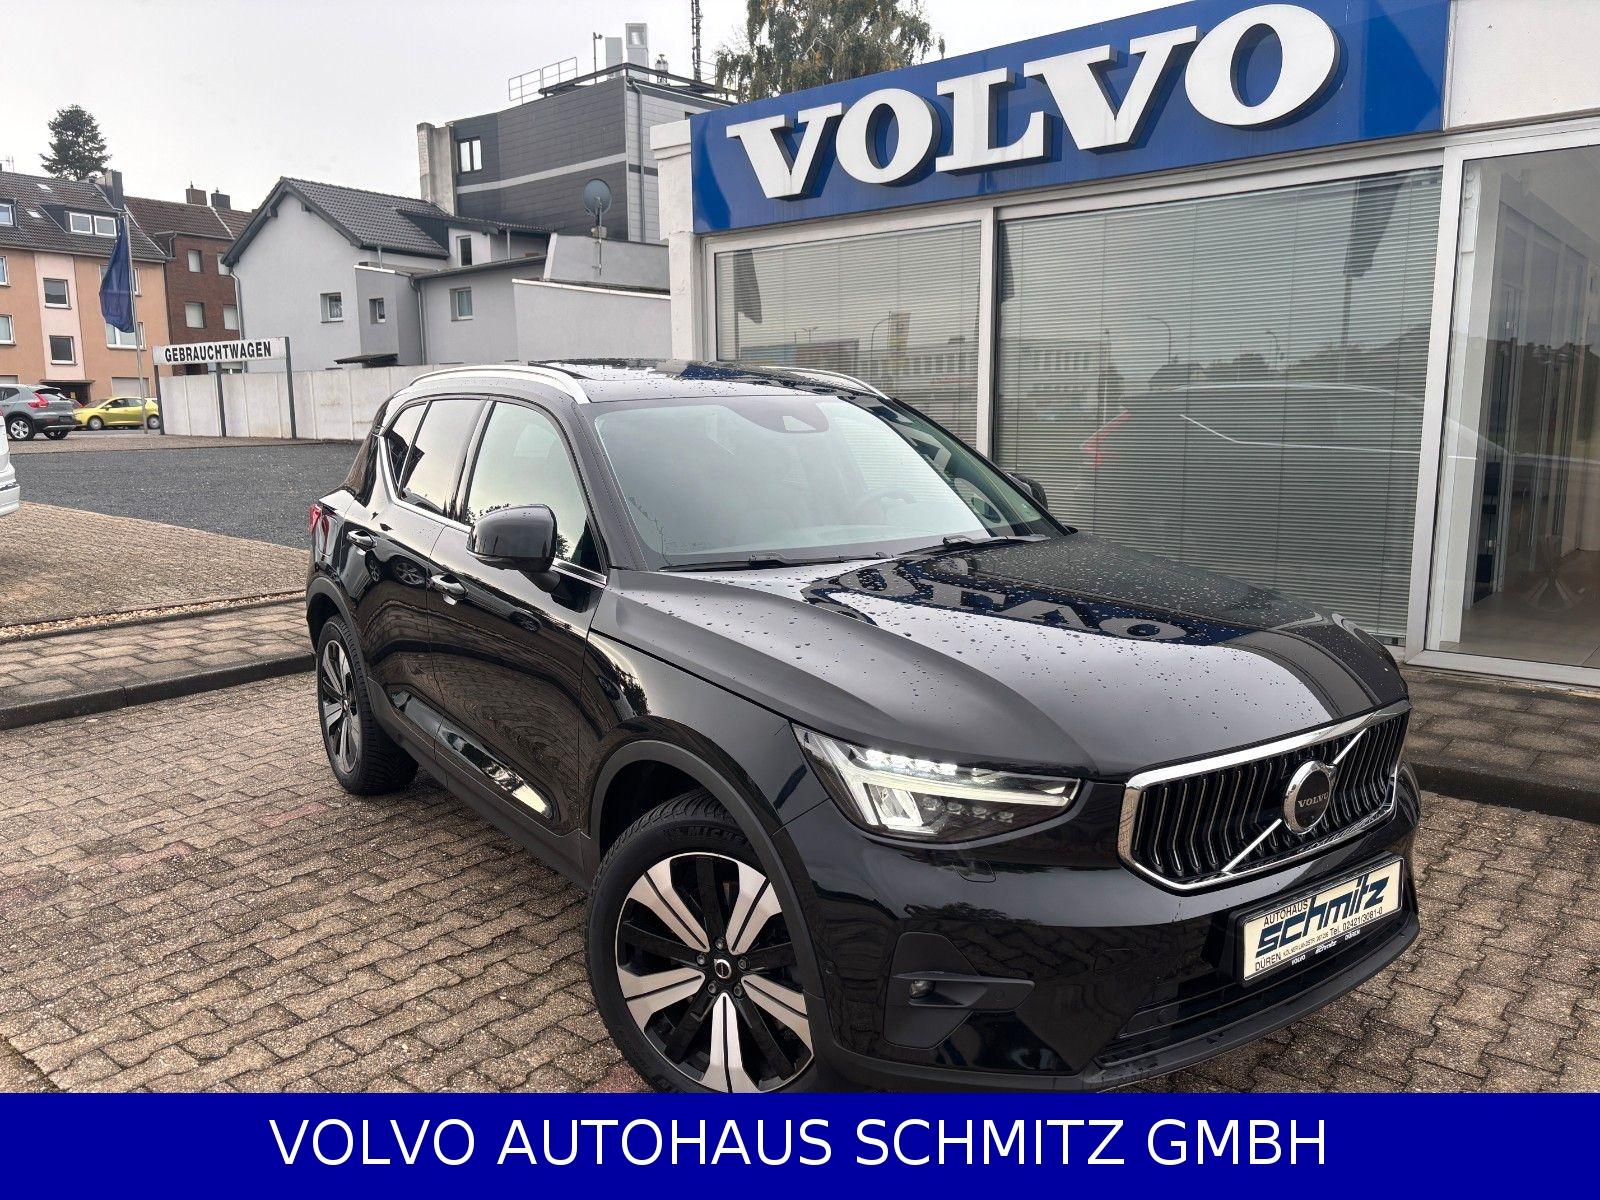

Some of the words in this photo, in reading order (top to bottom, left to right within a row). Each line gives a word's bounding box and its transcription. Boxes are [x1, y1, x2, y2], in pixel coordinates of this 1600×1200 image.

[726, 3, 1340, 200] VOLVO
[164, 341, 272, 362] GEBRAUCHTWAGEN
[1297, 792, 1329, 808] VOLVO
[1263, 899, 1308, 927] AUTOHAUS
[1255, 952, 1281, 972] DÜREN
